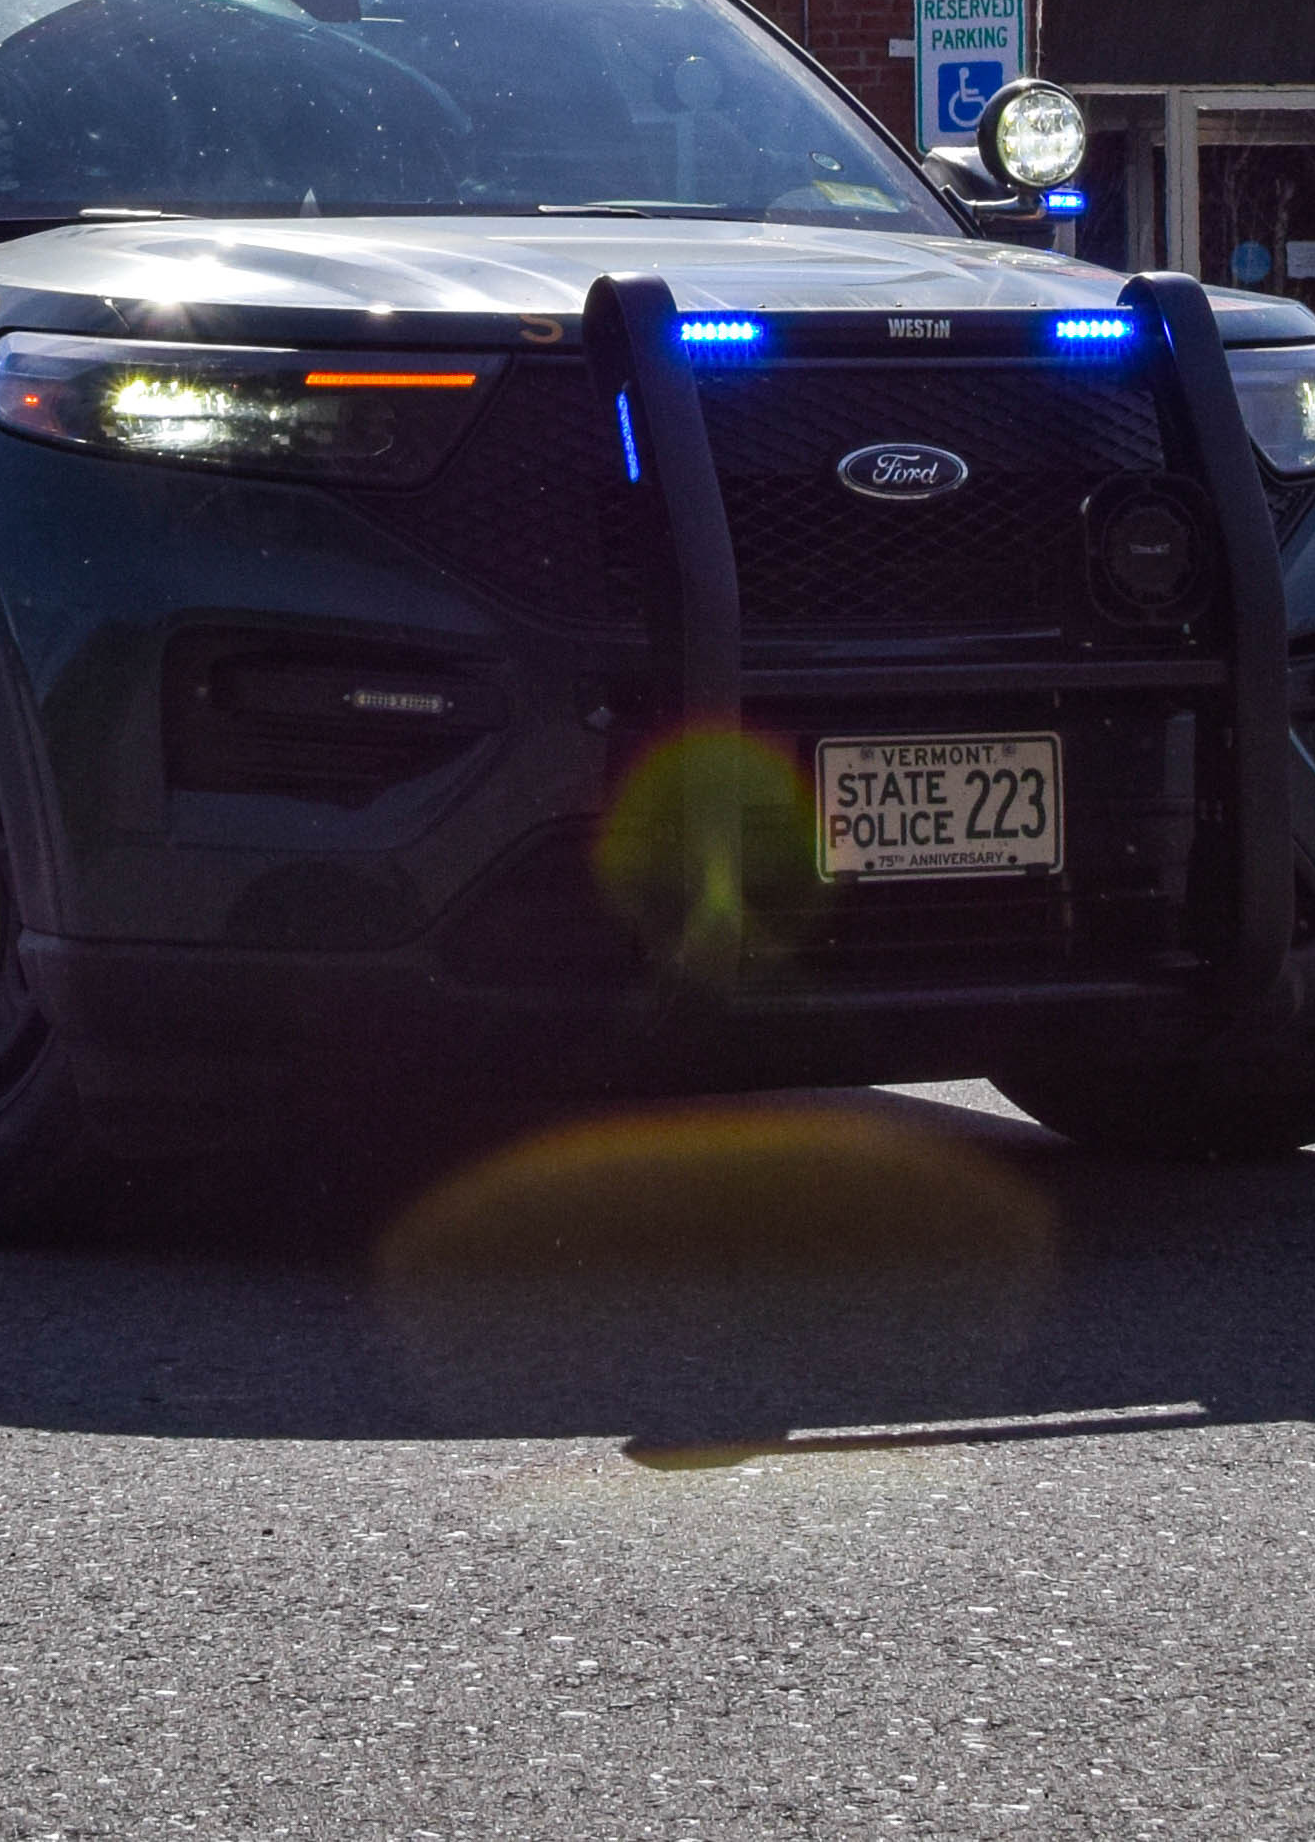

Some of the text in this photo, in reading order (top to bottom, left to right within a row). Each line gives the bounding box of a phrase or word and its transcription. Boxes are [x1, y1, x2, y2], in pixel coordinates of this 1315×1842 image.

[931, 26, 1008, 51] PARKING
[872, 453, 939, 485] Ford
[880, 745, 995, 768] VERMONT
[837, 770, 948, 808] STATE
[965, 767, 1047, 840] 223
[829, 810, 954, 849] POLICE
[909, 850, 1004, 868] ANNIVERSARY
